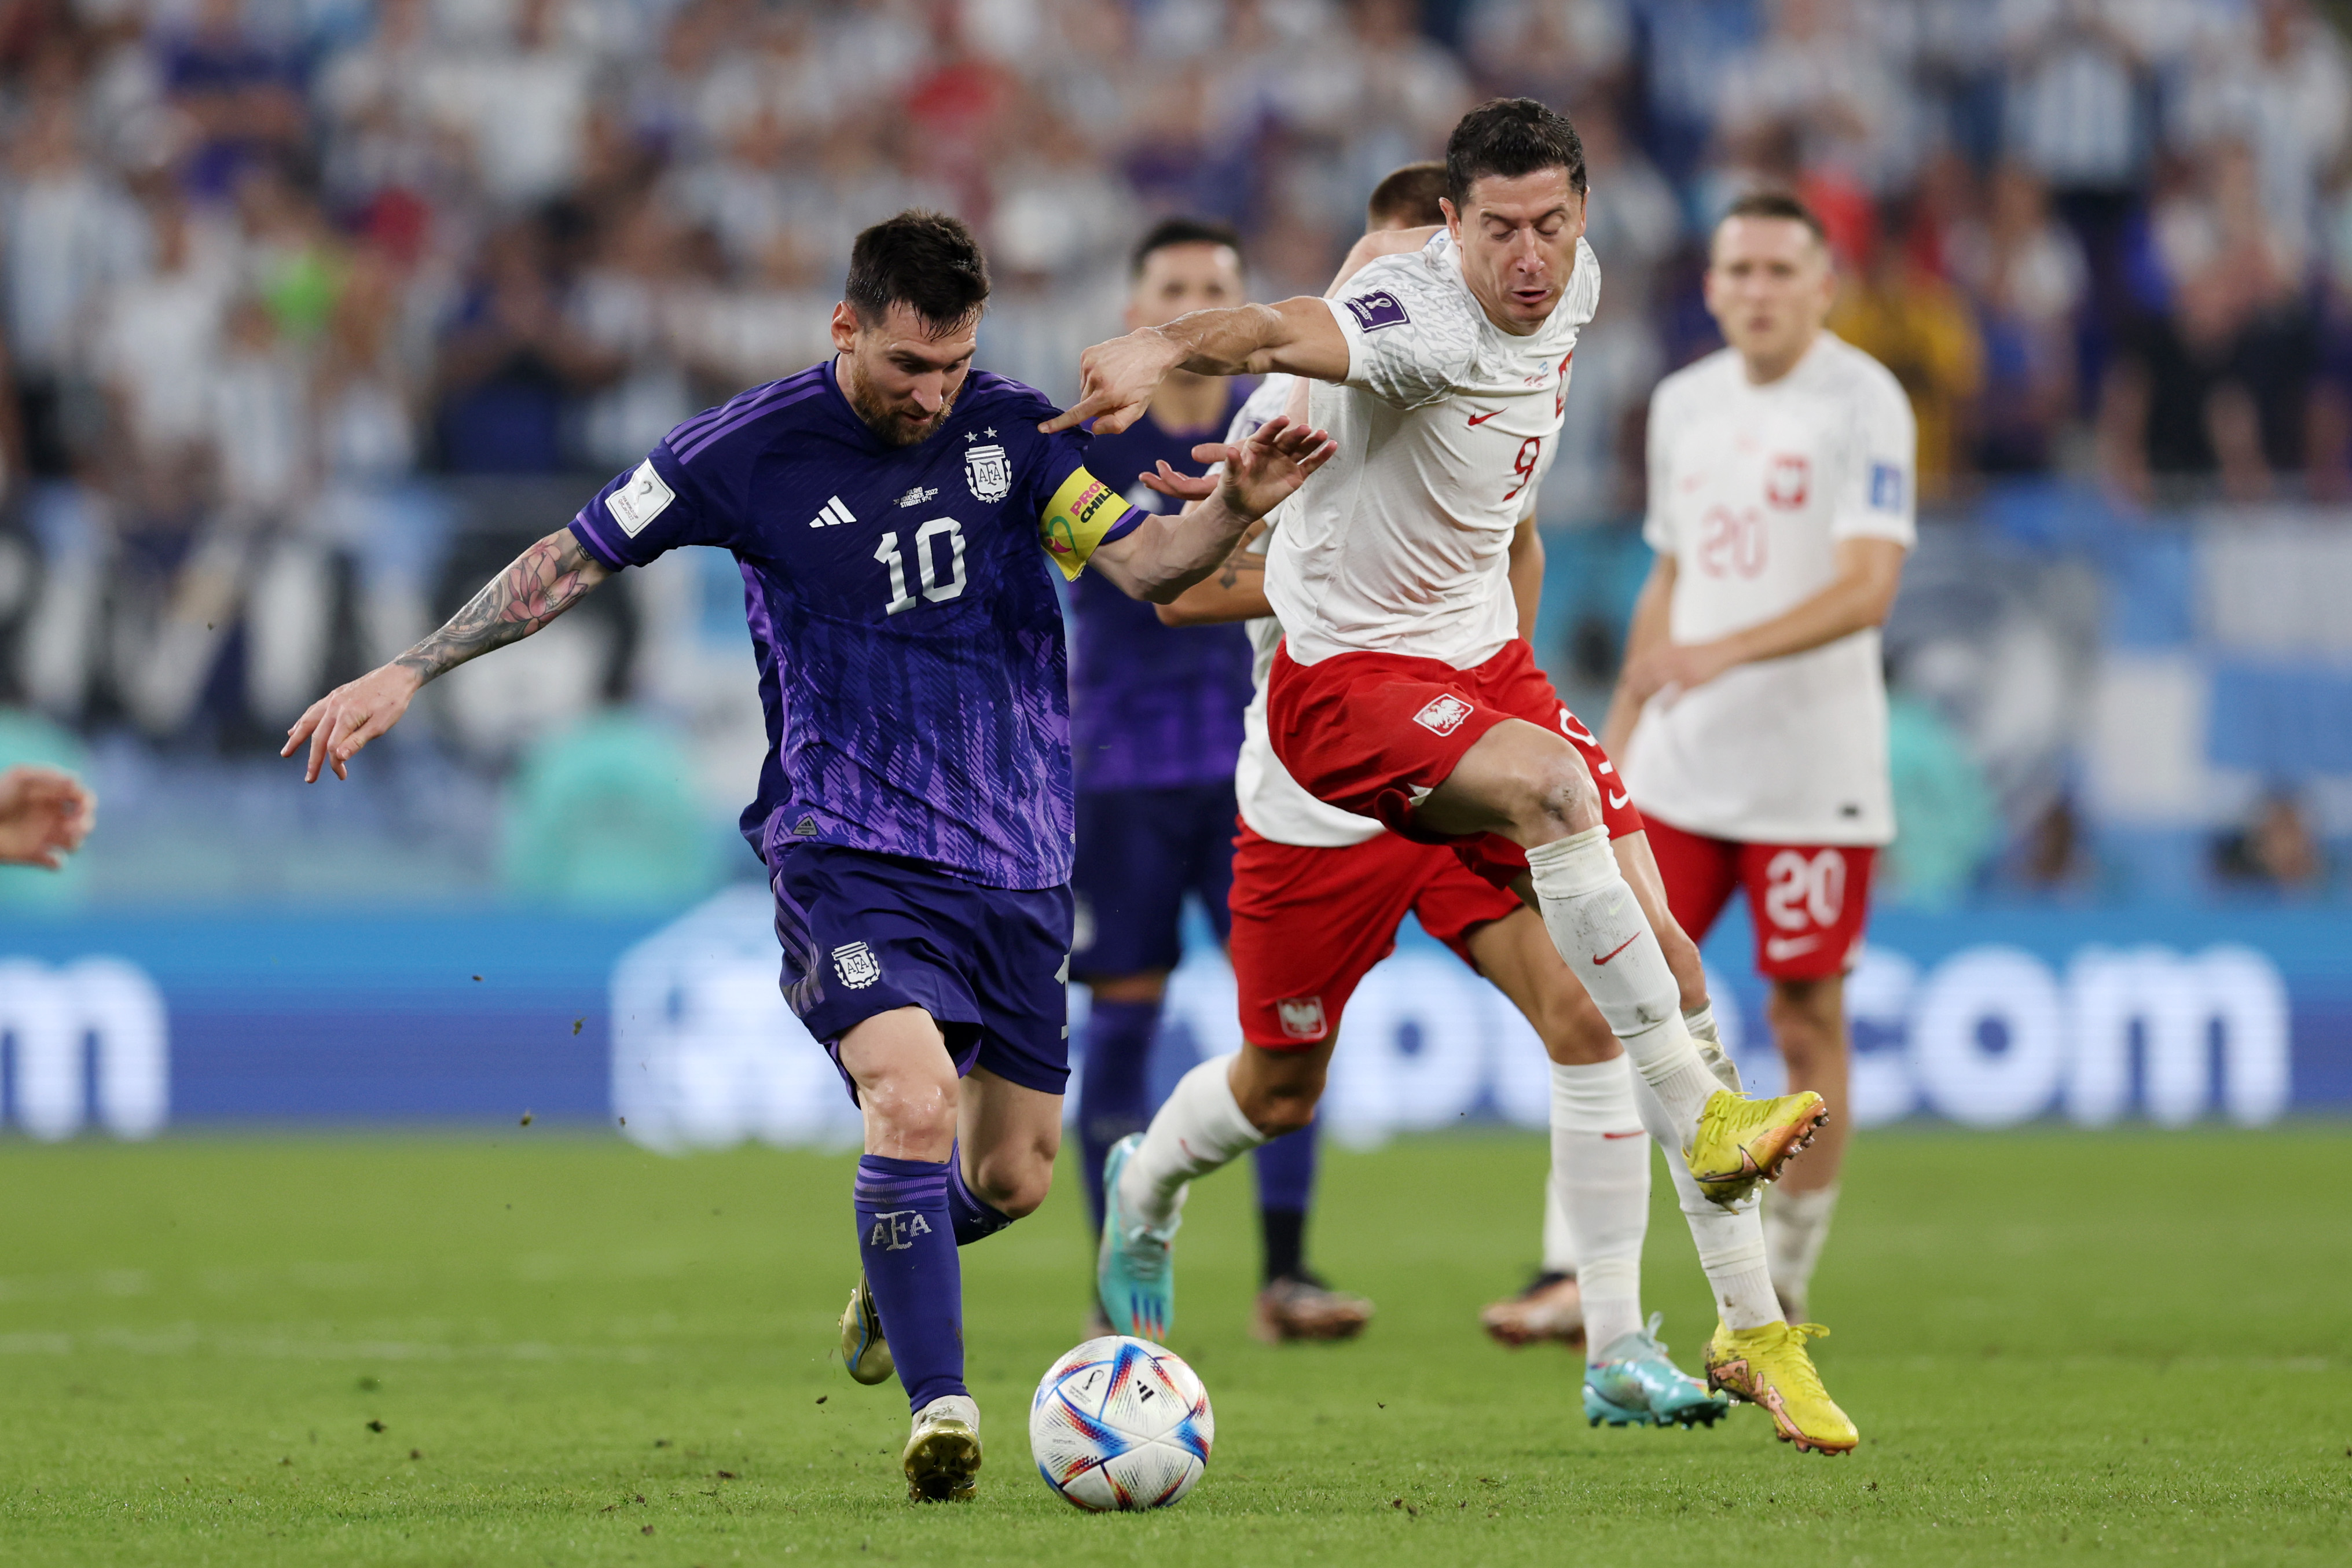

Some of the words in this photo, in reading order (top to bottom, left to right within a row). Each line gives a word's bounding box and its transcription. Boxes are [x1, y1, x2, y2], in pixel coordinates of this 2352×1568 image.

[924, 488, 939, 496] 2022
[979, 461, 1003, 486] AFA
[1502, 436, 1540, 502] 9
[873, 516, 967, 616] 10
[1697, 504, 1769, 581] 20
[1766, 847, 1848, 931] 20
[846, 954, 869, 975] AFA
[1054, 953, 1071, 1040] 1
[871, 1210, 933, 1251] AFA
